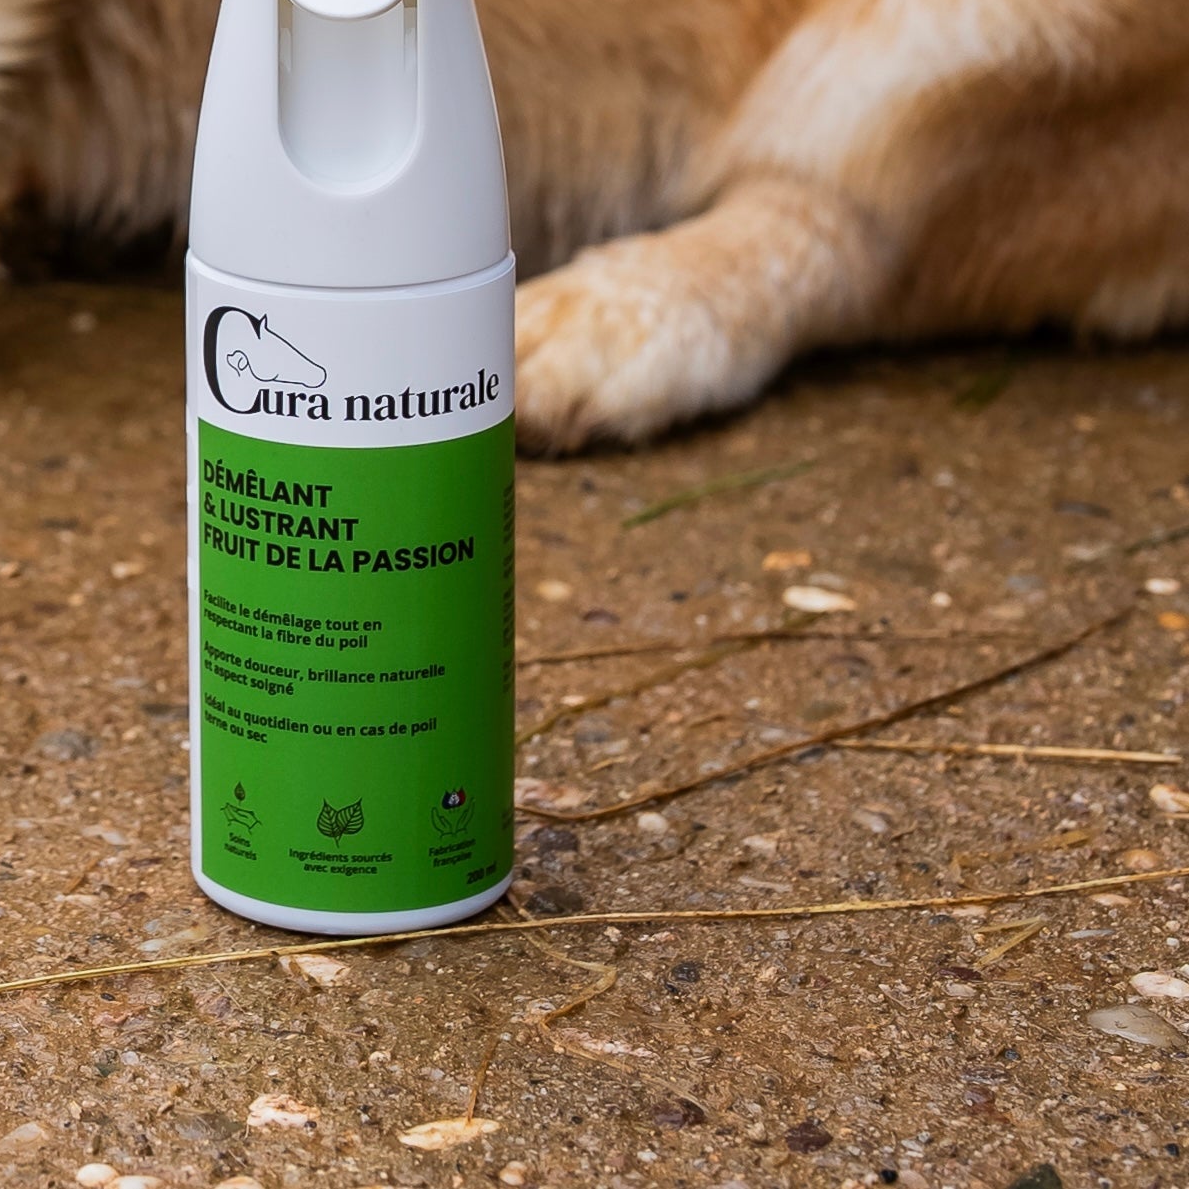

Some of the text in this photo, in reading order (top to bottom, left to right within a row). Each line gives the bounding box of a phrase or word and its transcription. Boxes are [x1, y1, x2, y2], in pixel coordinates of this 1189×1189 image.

[203, 306, 500, 422] Cura naturale
[203, 458, 333, 508] DÉMÊLANT
[203, 491, 359, 541] & LUSTRANT
[203, 522, 260, 562] FRUIT
[266, 542, 301, 570] DE
[308, 548, 345, 573] LA
[352, 536, 474, 573] PASSION
[204, 589, 382, 632] Facilite le démêlage tout en
[204, 608, 368, 651] respectant la fibre du poil
[204, 640, 445, 683] Apporte douceur, brillance naturelle
[204, 660, 294, 696] et aspect soigné
[204, 692, 437, 737] Idéal au quotidien ou en cas de poil
[205, 710, 268, 743] terne ou sec
[289, 848, 393, 863] Ingrédients sourcés
[303, 863, 378, 876] avec exigence
